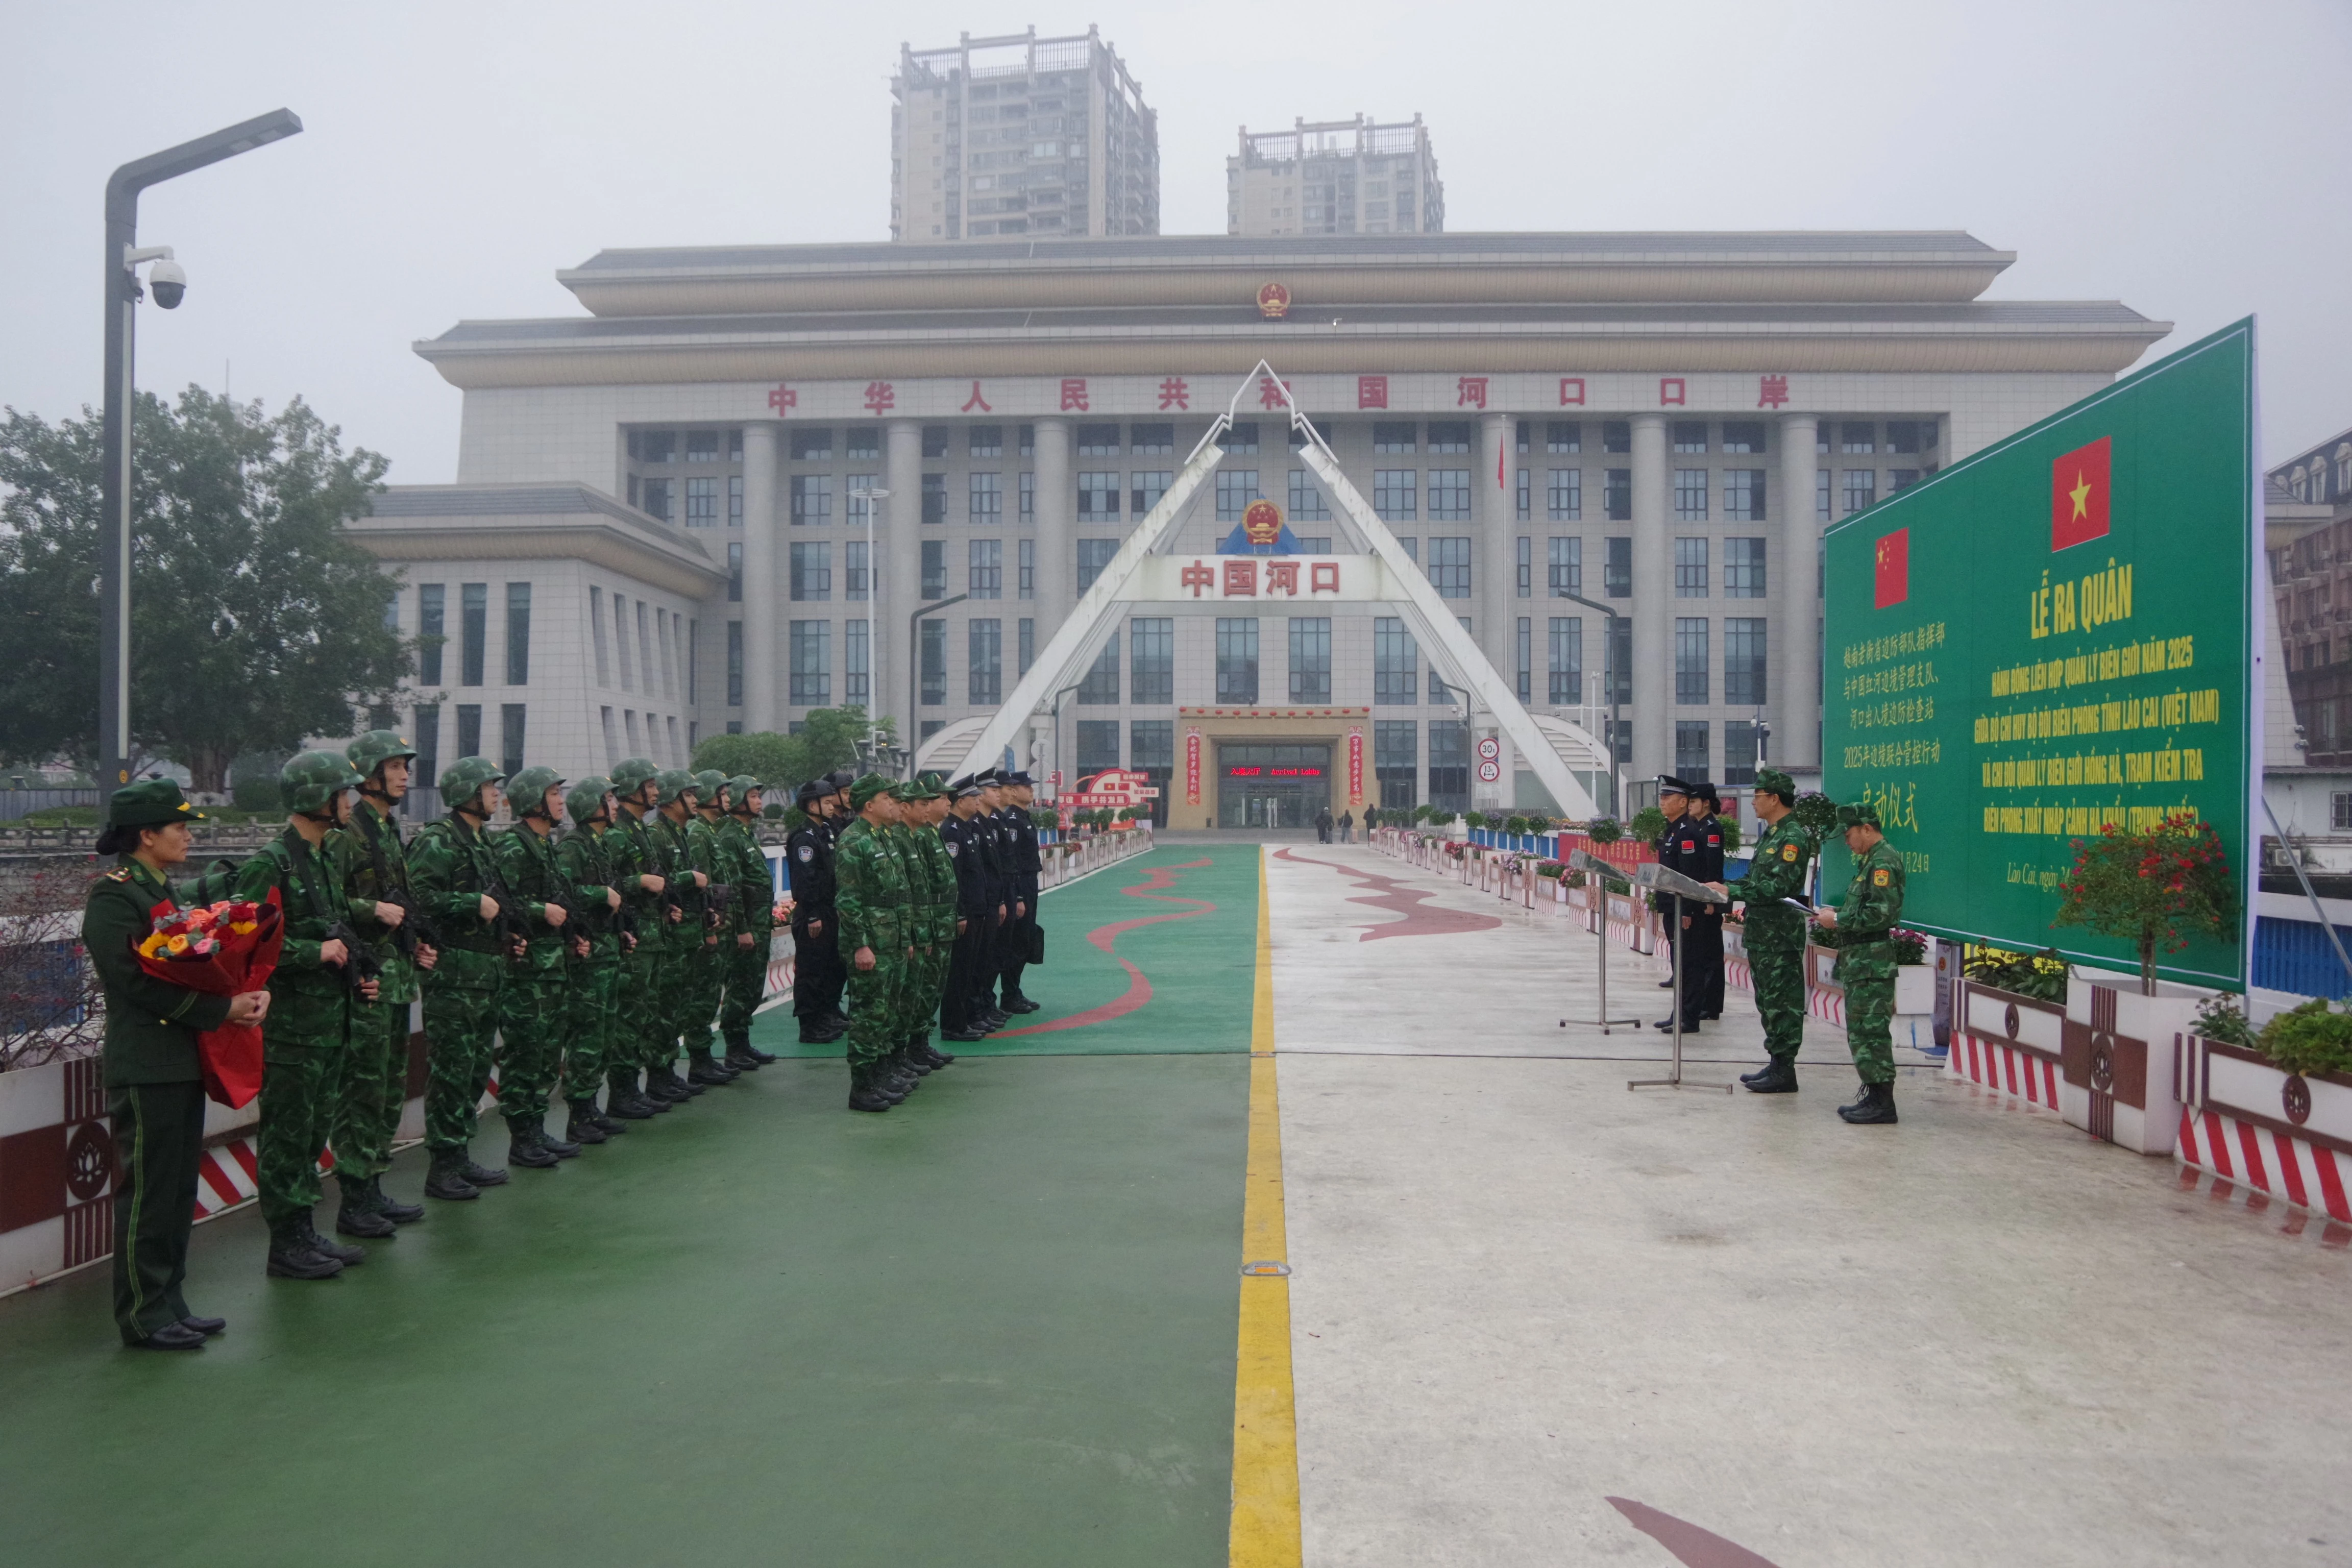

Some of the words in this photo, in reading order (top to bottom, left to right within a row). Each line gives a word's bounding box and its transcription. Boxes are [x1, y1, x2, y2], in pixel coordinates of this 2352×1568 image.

[768, 375, 1788, 416] 中华人民共和国河口口岸
[1182, 560, 1339, 597] 中国河口
[2030, 569, 2049, 640] LỄ
[2054, 581, 2075, 634] RA
[2080, 557, 2132, 633] QUÂN
[1844, 621, 1945, 669] 越南老街省边防部队指挥部
[1992, 666, 2010, 697] HÀNH
[2011, 663, 2029, 700] ĐỘNG
[2031, 658, 2046, 692] LIÊN
[2048, 657, 2063, 694] HỢP
[2065, 647, 2087, 689] QUẢN
[2089, 647, 2098, 683] LÝ
[2100, 644, 2120, 680] BIÊN
[2122, 639, 2140, 677] GIỚI
[2142, 635, 2166, 674] NĂM
[2167, 635, 2193, 670] 2025
[1850, 695, 1933, 730] 河口出入境边防检查站
[1974, 713, 1989, 744] GIỮA
[1990, 712, 1999, 748] BỘ
[2000, 706, 2012, 742] CHỈ
[2013, 714, 2026, 740] HUY
[2027, 706, 2037, 745] BỘ
[2039, 705, 2051, 744] ĐỘI
[2052, 702, 2070, 737] BIÊN
[2072, 698, 2099, 735] PHÒNG
[2101, 693, 2121, 732] TỈNH
[2123, 693, 2140, 730] LÀO
[2143, 696, 2159, 728] CAI
[2162, 686, 2187, 732] (VIỆT
[2190, 689, 2219, 725] NAM)
[1190, 738, 1198, 791] 金蛇贺岁迎春到
[1482, 745, 1495, 753] 30t
[1844, 738, 1940, 768] 2025年边境联合管控行动
[1982, 757, 1991, 788] VÀ
[1992, 762, 2003, 788] CHI
[2004, 755, 2016, 793] ĐỘI
[2017, 751, 2036, 790] QUẢN
[2037, 753, 2046, 786] LÝ
[2047, 752, 2065, 786] BIÊN
[2067, 751, 2082, 785] GIỚI
[2084, 746, 2107, 785] HỒNG
[2109, 747, 2123, 788] HÀ,
[2125, 752, 2152, 790] TRẠM
[2154, 737, 2180, 782] KIỂM
[2183, 748, 2203, 780] TRA
[1231, 767, 1261, 775] 入境大厅
[1082, 796, 1124, 804] 携手共发展
[1984, 801, 1999, 832] BIÊN
[2000, 801, 2023, 833] PHÒNG
[2024, 797, 2042, 834] XUẤT
[2044, 801, 2064, 841] NHẬP
[2066, 798, 2088, 836] CẢNH
[2089, 801, 2100, 836] HÀ
[2128, 806, 2164, 837] (TRUNG
[2007, 862, 2020, 883] Lào
[2023, 863, 2037, 886] Cai,
[2039, 865, 2058, 893] ngày
